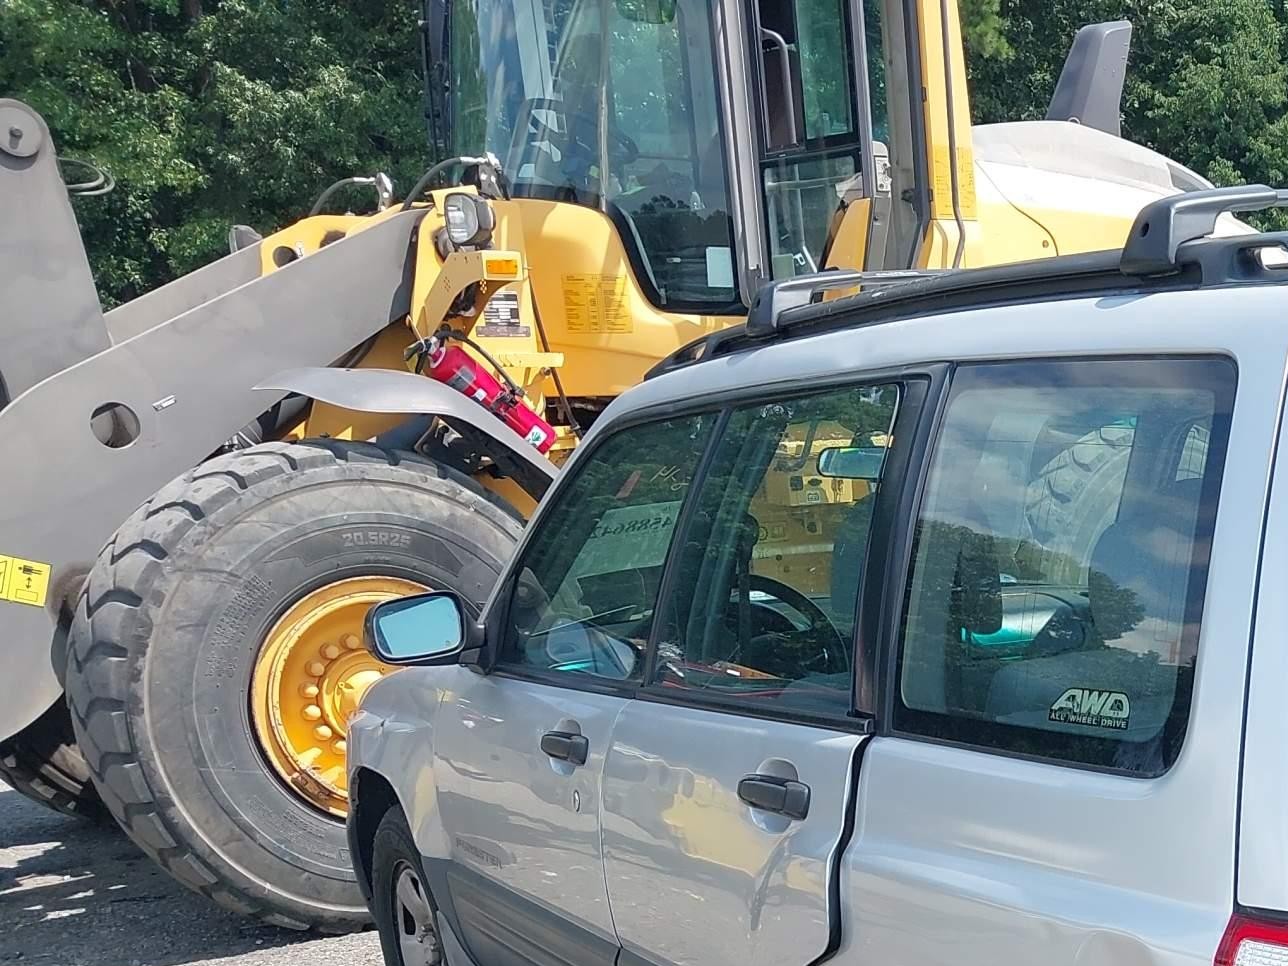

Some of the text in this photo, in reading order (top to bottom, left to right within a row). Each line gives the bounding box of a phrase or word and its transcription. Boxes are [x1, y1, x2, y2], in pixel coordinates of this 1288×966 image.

[342, 531, 411, 547] 20.5R25
[1051, 688, 1130, 718] AWD
[1050, 711, 1127, 729] ALL WHEEL DRIVE
